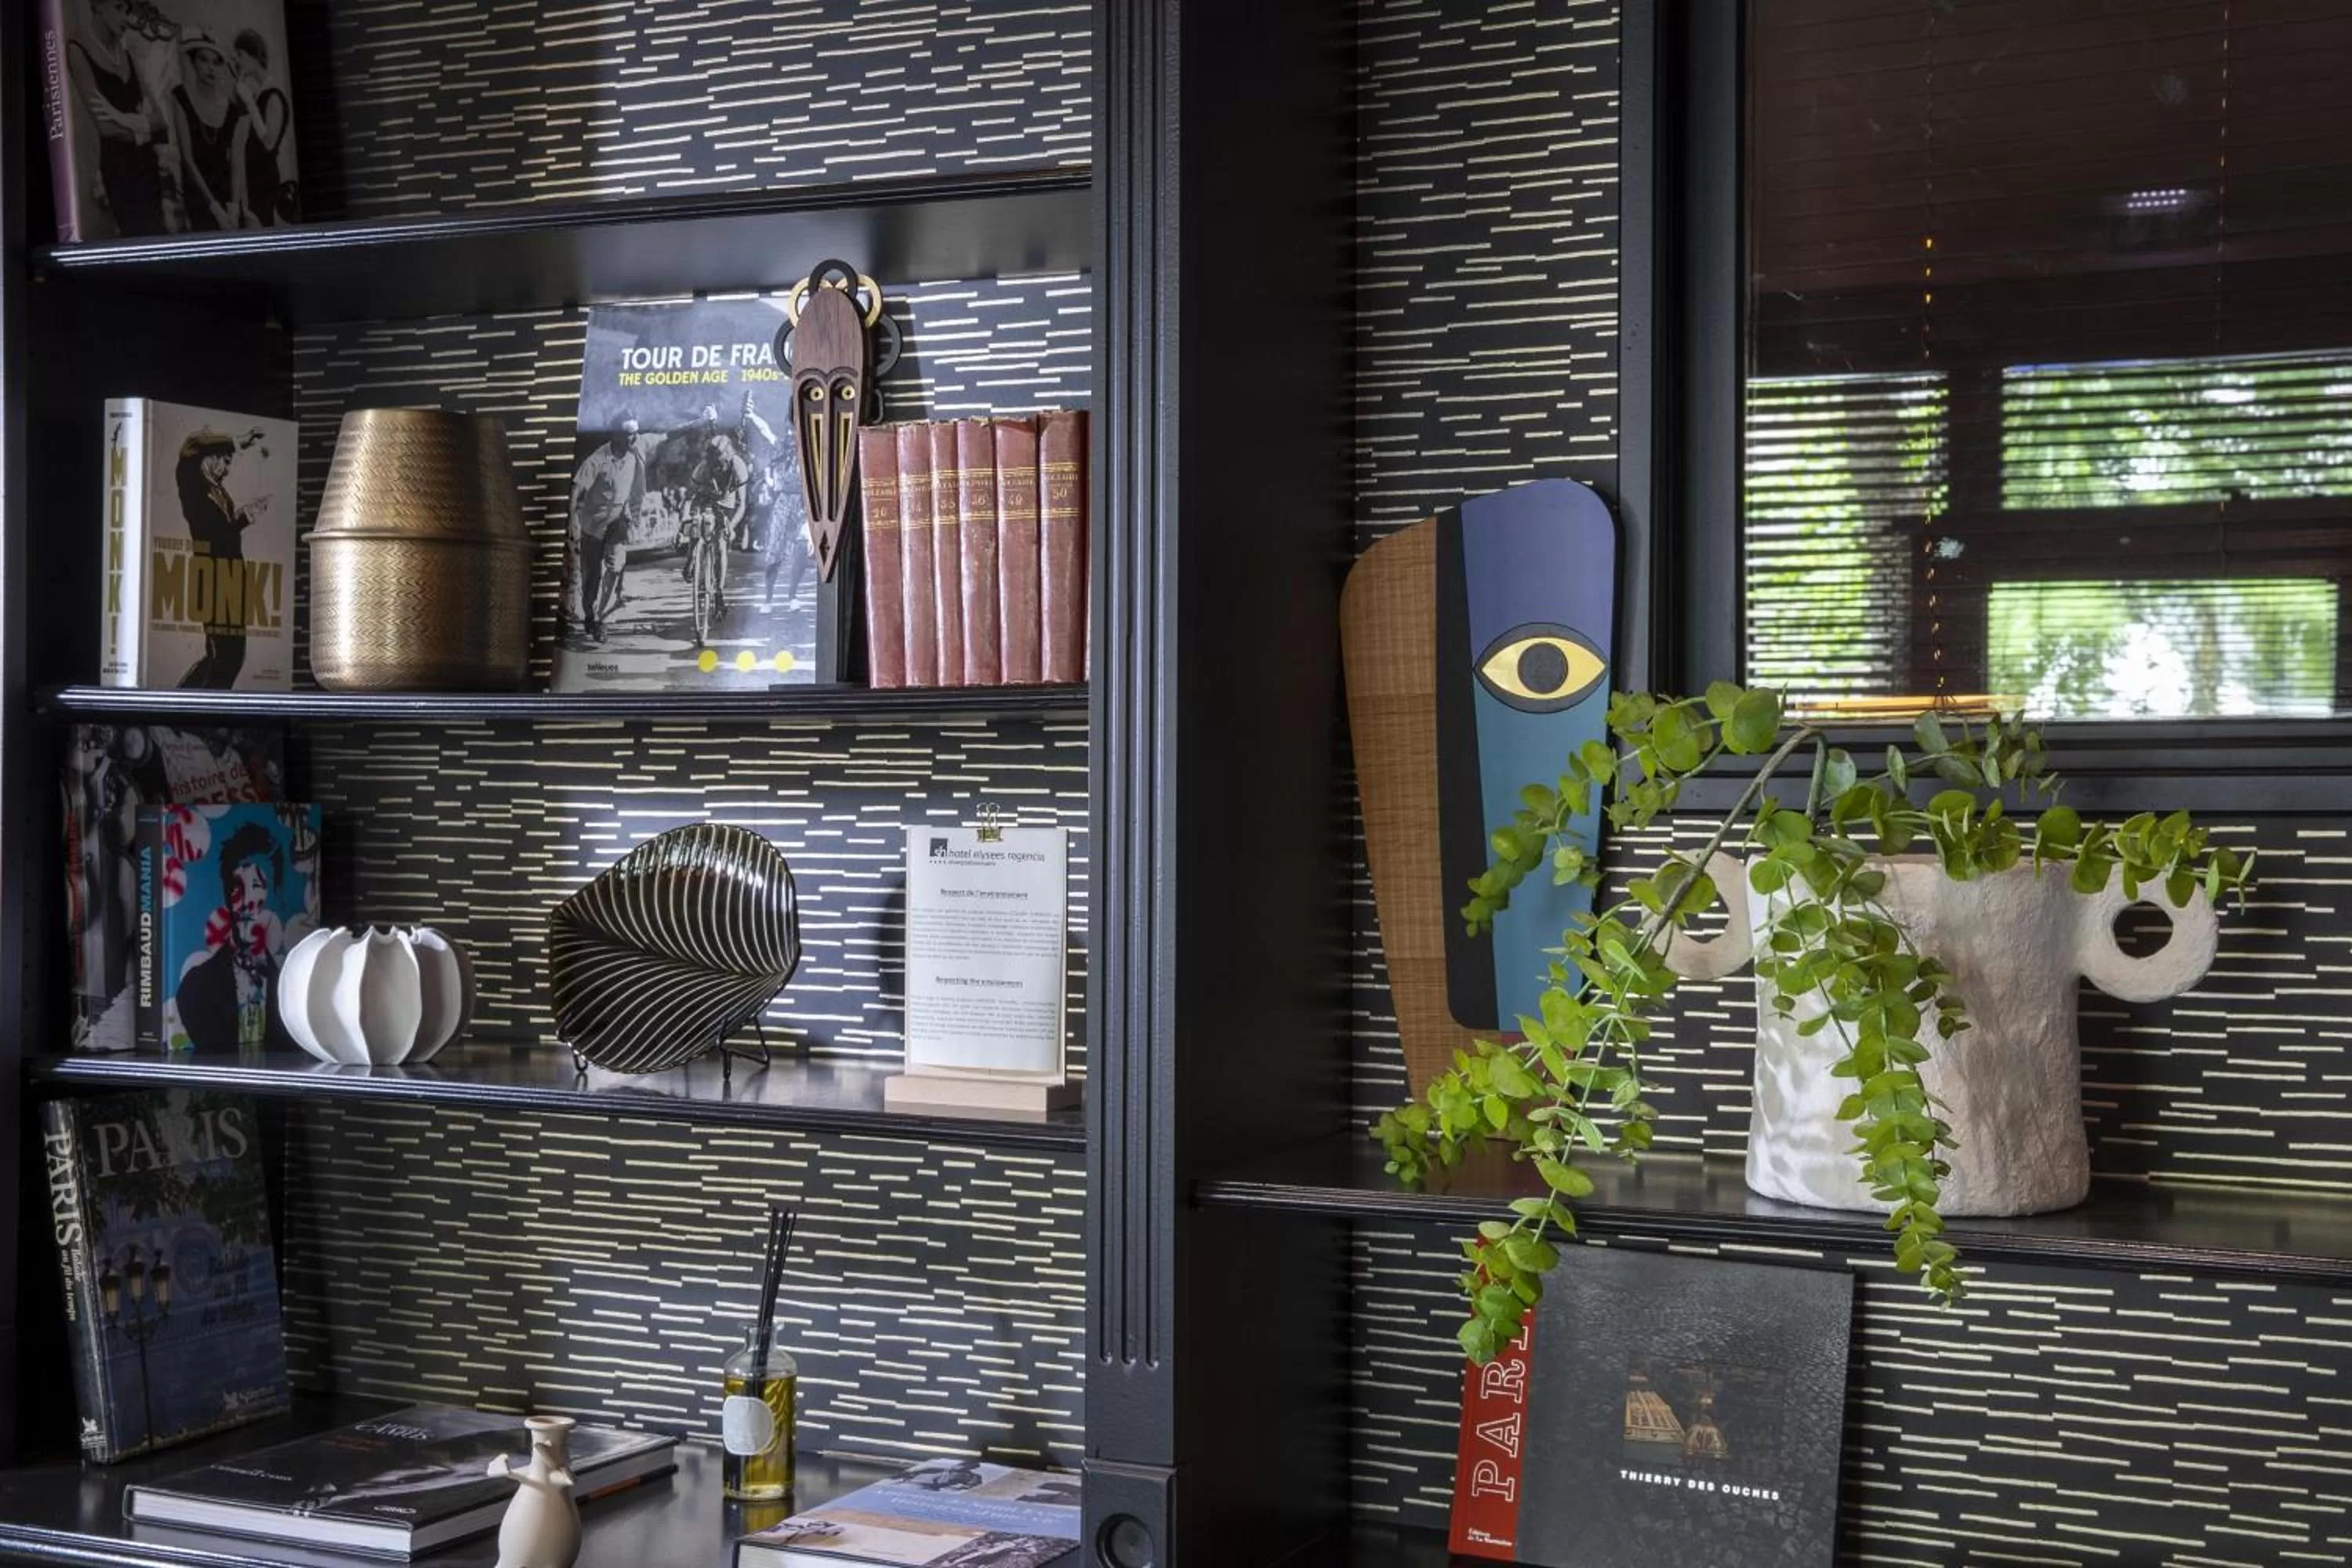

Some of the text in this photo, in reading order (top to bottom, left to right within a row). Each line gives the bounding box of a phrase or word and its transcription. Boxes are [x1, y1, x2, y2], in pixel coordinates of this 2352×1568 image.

[44, 30, 64, 140] Parisiennes
[619, 372, 642, 386] THE
[645, 371, 699, 385] GOLDEN
[701, 370, 728, 383] AGE
[622, 347, 684, 369] TOUR
[691, 345, 724, 368] DE
[152, 551, 283, 628] MONK!
[949, 849, 971, 858] hotel
[92, 1107, 248, 1177] PARIS
[44, 1129, 82, 1247] PARIS
[1472, 1305, 1531, 1503] PAR
[1620, 1470, 1780, 1501] THIERRY DES OUCHES
